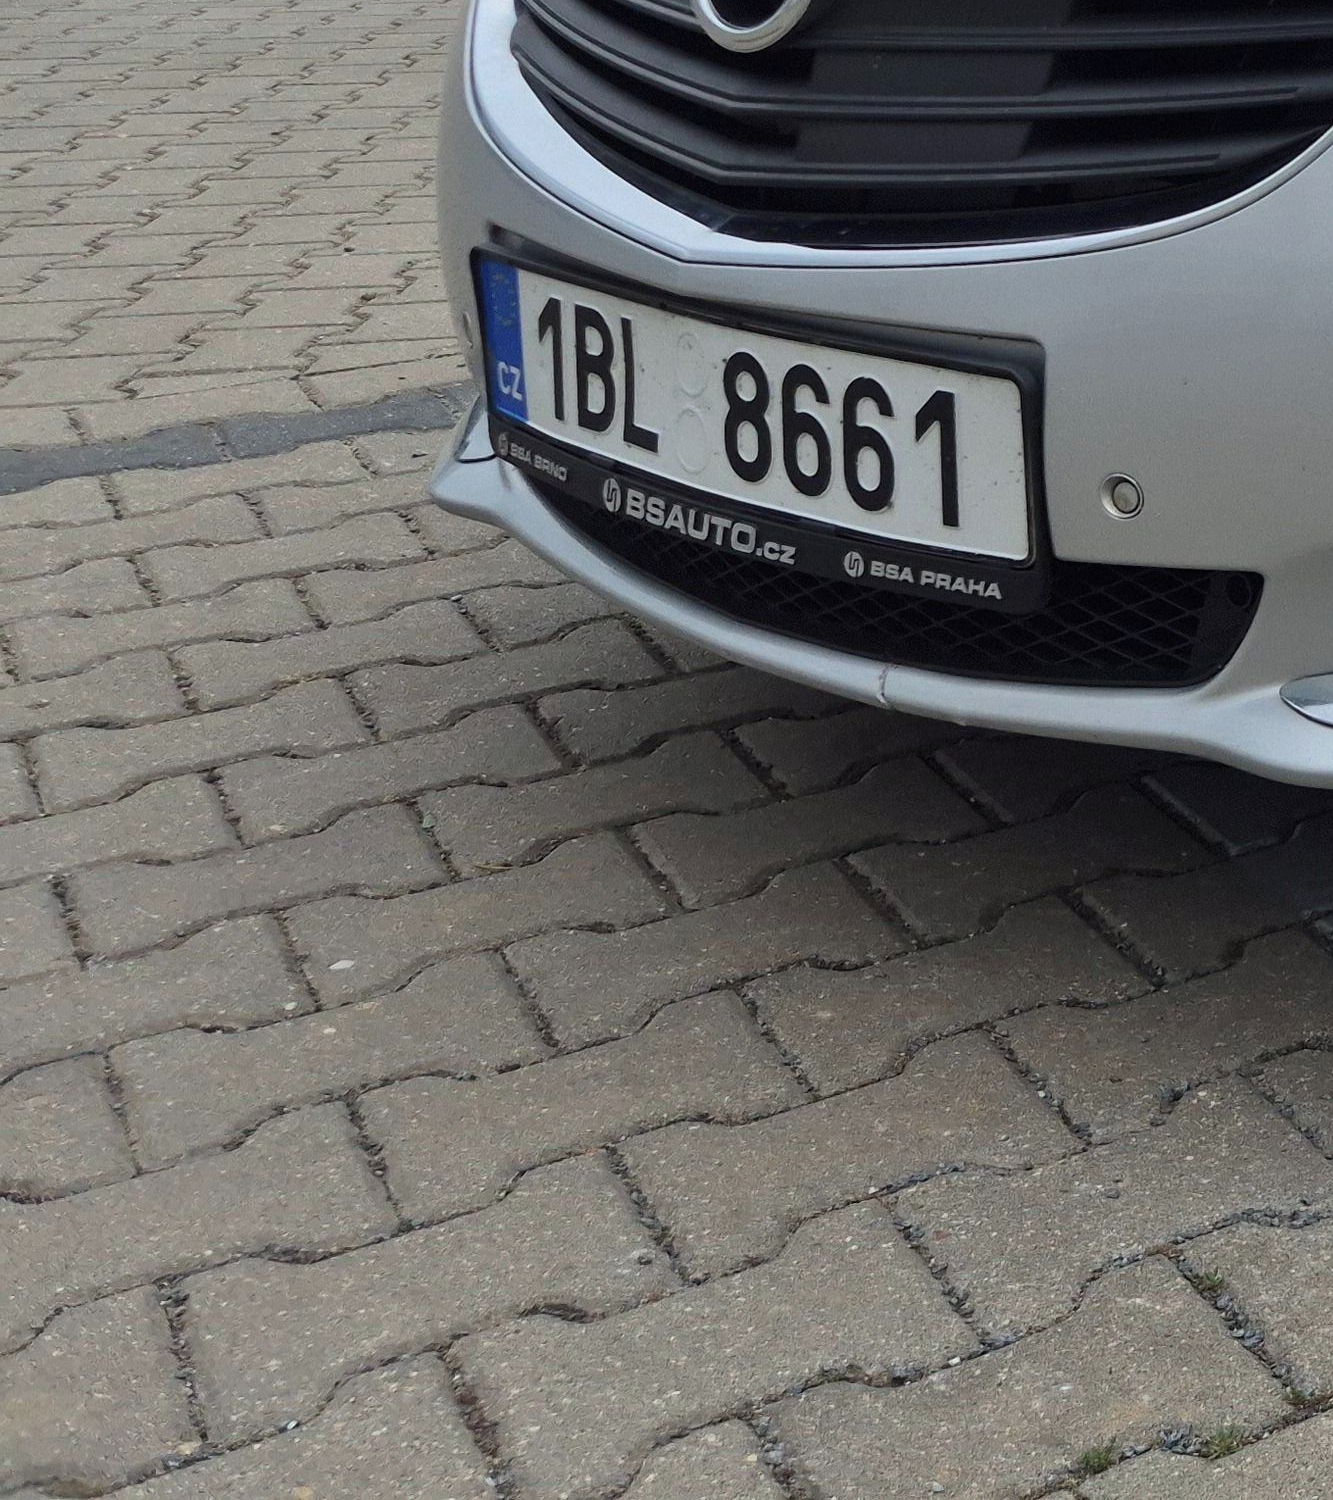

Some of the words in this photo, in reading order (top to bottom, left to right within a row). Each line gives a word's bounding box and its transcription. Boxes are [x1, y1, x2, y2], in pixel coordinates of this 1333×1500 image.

[497, 361, 523, 401] CZ
[537, 296, 660, 454] 1BL
[722, 351, 961, 528] 8661
[534, 455, 569, 483] BRNO
[870, 560, 915, 584] BSA
[920, 570, 1003, 600] PRAHA
